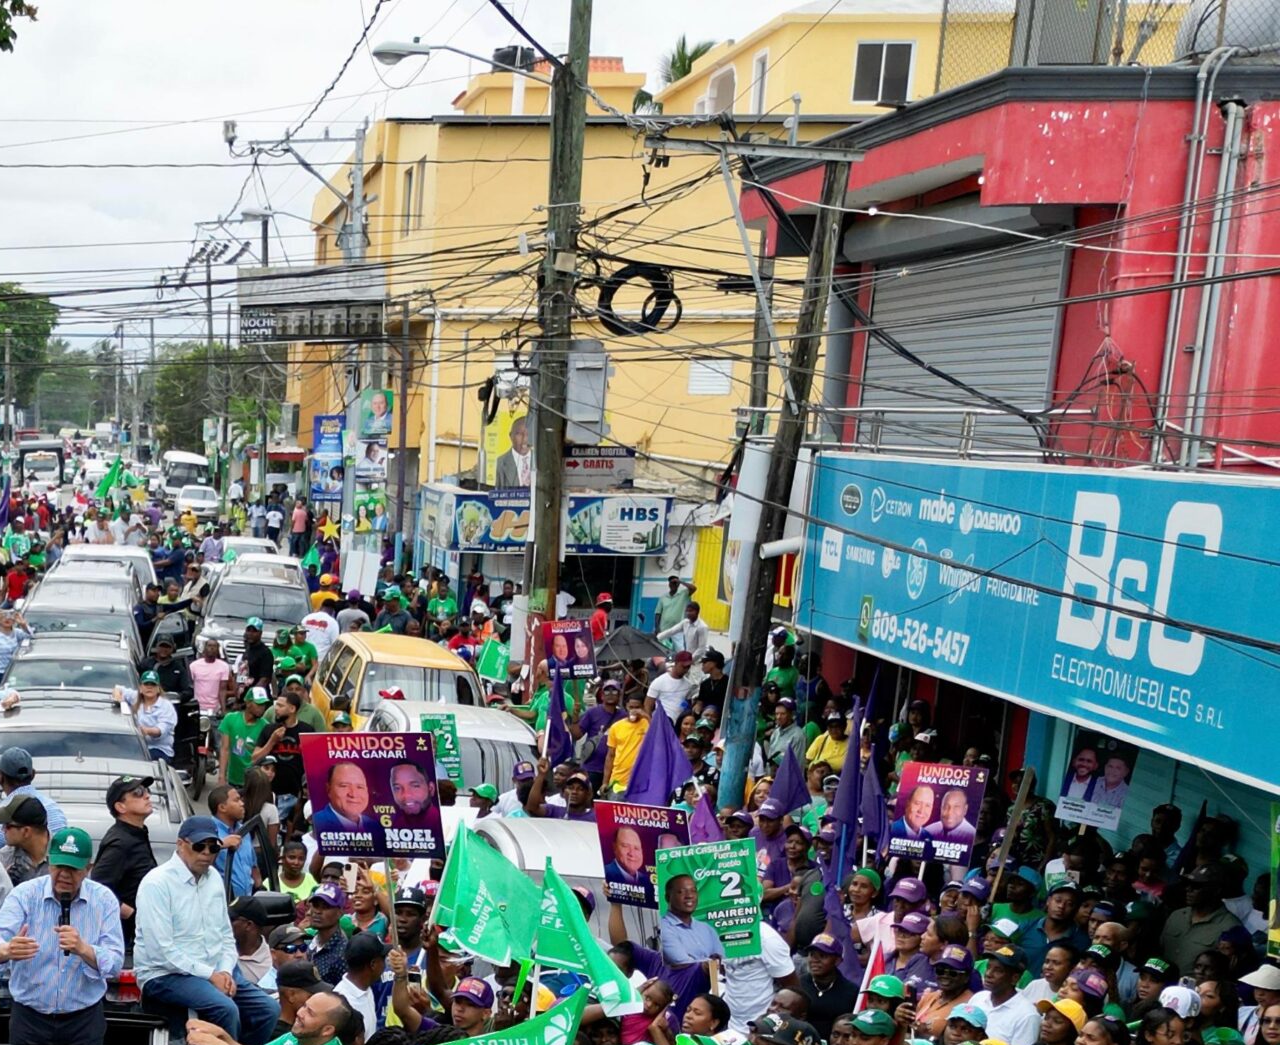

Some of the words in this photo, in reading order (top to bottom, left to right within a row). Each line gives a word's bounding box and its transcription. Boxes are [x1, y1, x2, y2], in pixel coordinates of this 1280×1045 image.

[240, 318, 277, 328] NOCHE
[583, 459, 615, 470] GRATIS
[886, 500, 913, 517] CETRON
[919, 488, 955, 524] mabe
[620, 507, 659, 521] HBS
[974, 510, 1020, 535] DAEWOO
[825, 540, 838, 557] TCL
[846, 544, 875, 566] SAMSUNG
[872, 609, 970, 666] 809-526-5457
[1051, 653, 1191, 718] ELECTROMUEBLES
[327, 736, 405, 750] ¡UNIDOS
[328, 750, 360, 759] PARA
[362, 750, 407, 759] GANAR!
[920, 764, 970, 780] ¡UNIDOS
[917, 776, 938, 785] PARA
[938, 777, 969, 788] GANAR!
[373, 805, 396, 814] VOTA
[613, 805, 668, 822] ¡UNIDOS
[380, 814, 393, 828] 6
[614, 816, 637, 825] PARA
[638, 820, 670, 829] GANAR!
[320, 832, 372, 841] CRISTIAN
[385, 829, 435, 842] NOEL
[386, 841, 436, 850] SORIANO
[890, 837, 925, 848] CRISTIAN
[646, 865, 656, 873] VOT
[609, 882, 645, 894] CRISTIAN
[720, 872, 742, 898] 2
[734, 897, 751, 905] POR
[707, 906, 757, 921] MAIRENI
[714, 917, 754, 928] CASTRO
